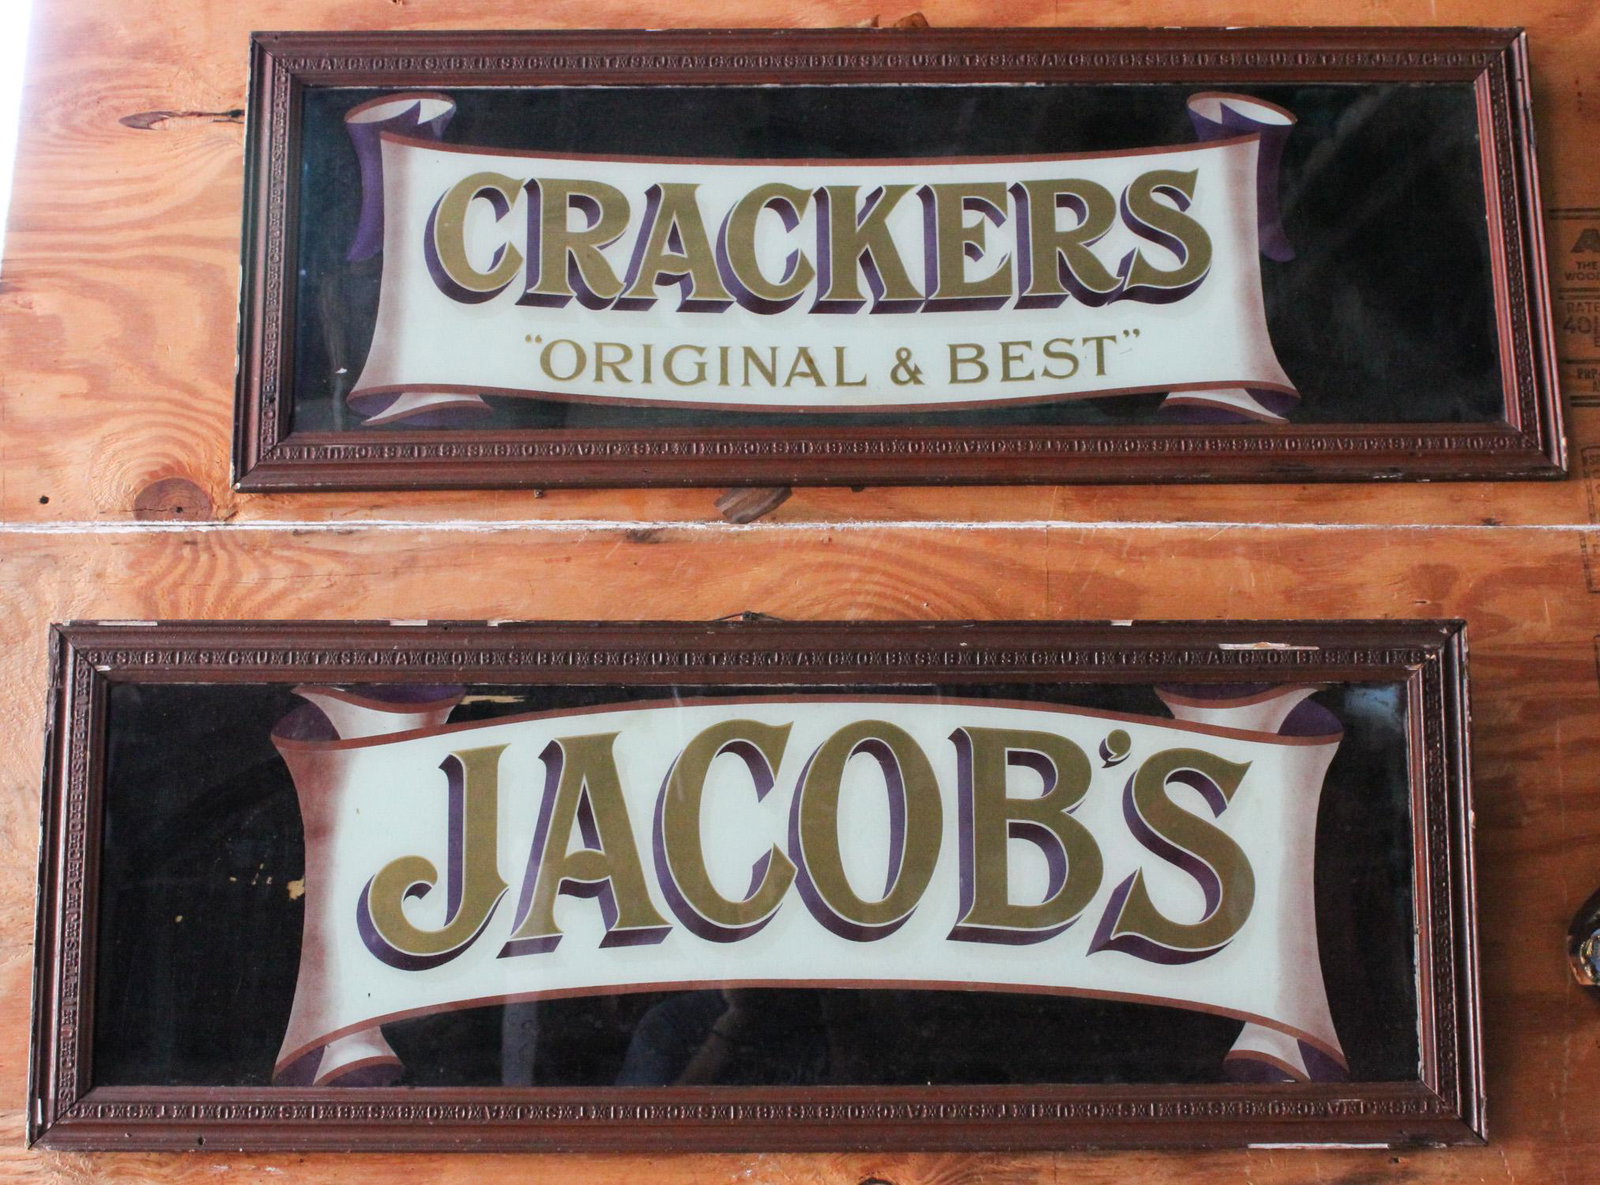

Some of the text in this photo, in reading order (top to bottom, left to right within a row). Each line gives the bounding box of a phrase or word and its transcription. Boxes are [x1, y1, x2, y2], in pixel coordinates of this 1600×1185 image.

[424, 168, 1213, 315] CRACKERS
[890, 347, 925, 386] &
[356, 718, 1257, 971] JACOB'S
